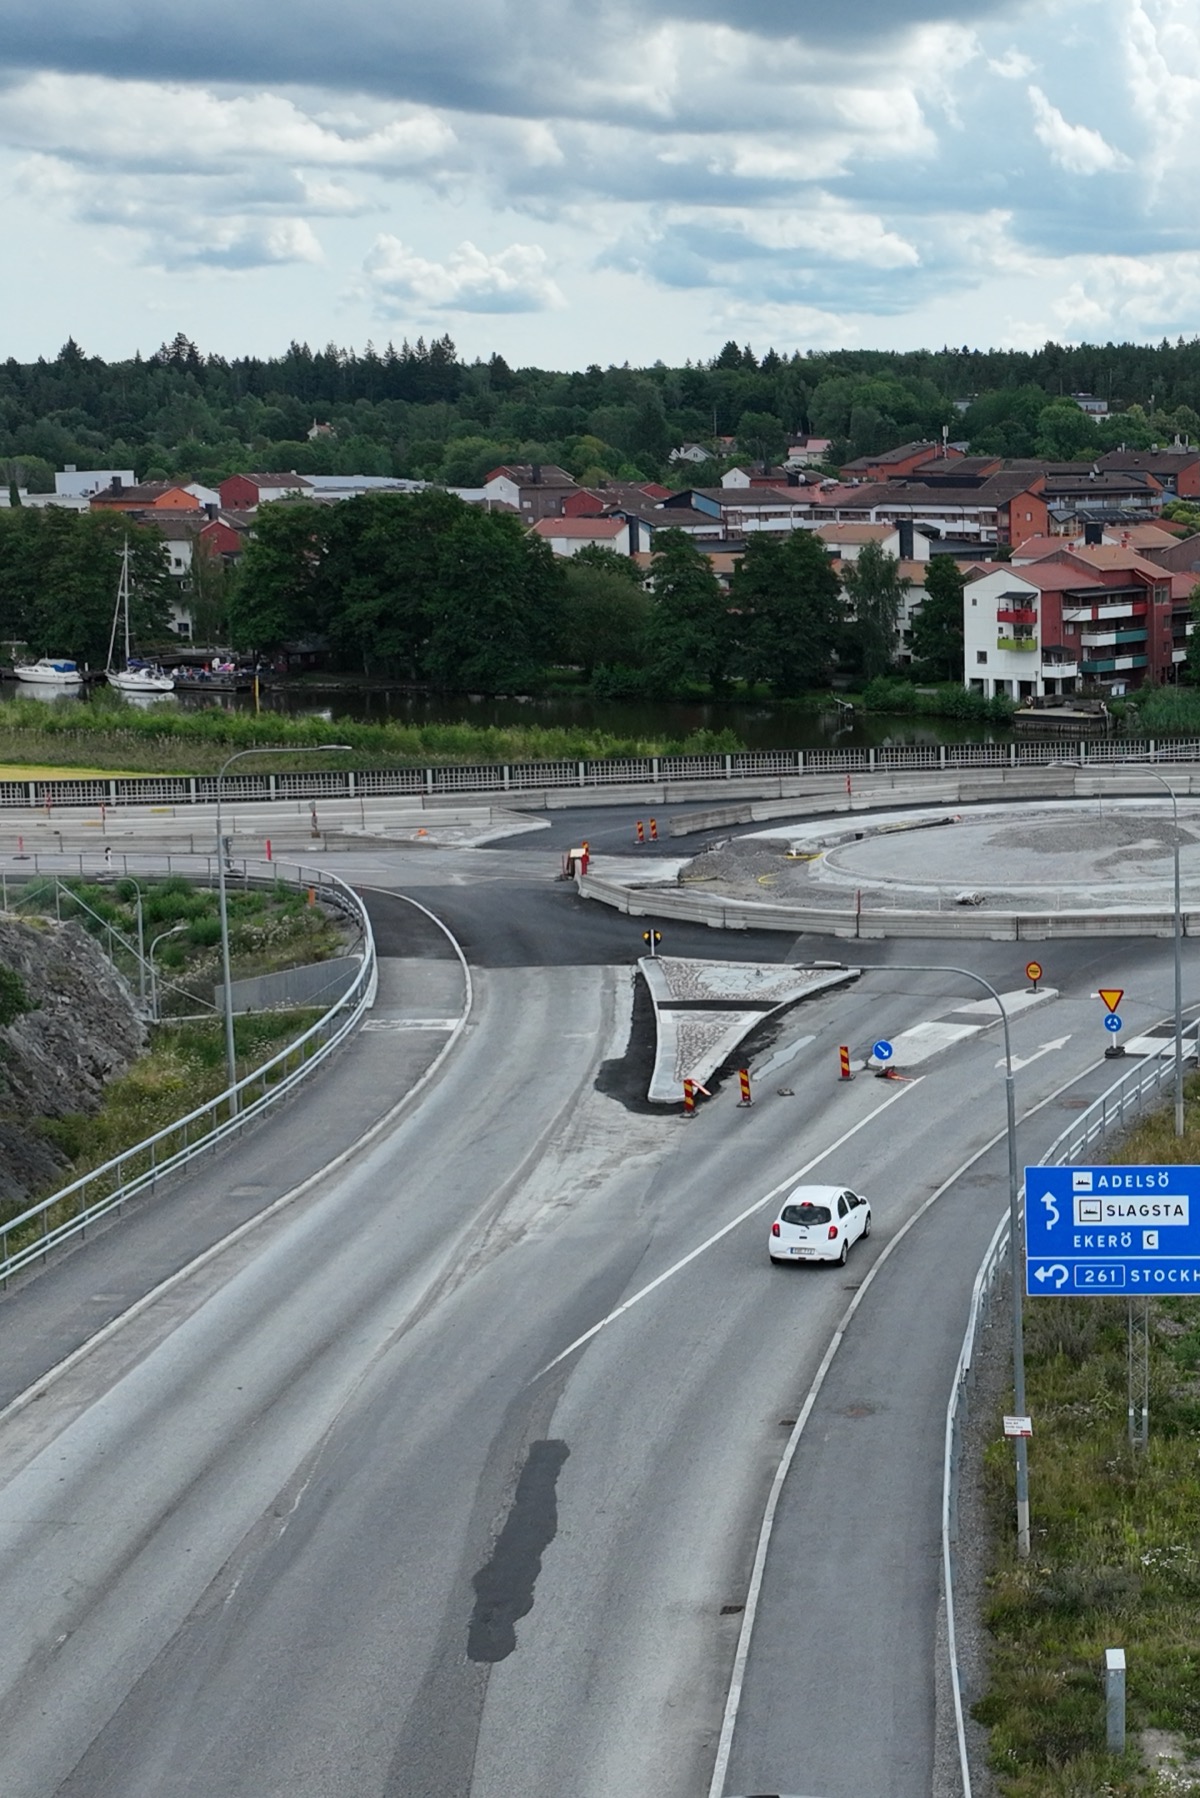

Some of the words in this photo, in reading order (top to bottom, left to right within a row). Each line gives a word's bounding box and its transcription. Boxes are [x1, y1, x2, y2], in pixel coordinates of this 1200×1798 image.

[1097, 1171, 1169, 1188] ADELSÖ
[1106, 1204, 1184, 1217] SLAGSTA
[1073, 1231, 1132, 1248] EKERÖ
[1146, 1233, 1155, 1246] C
[1084, 1269, 1116, 1282] 261
